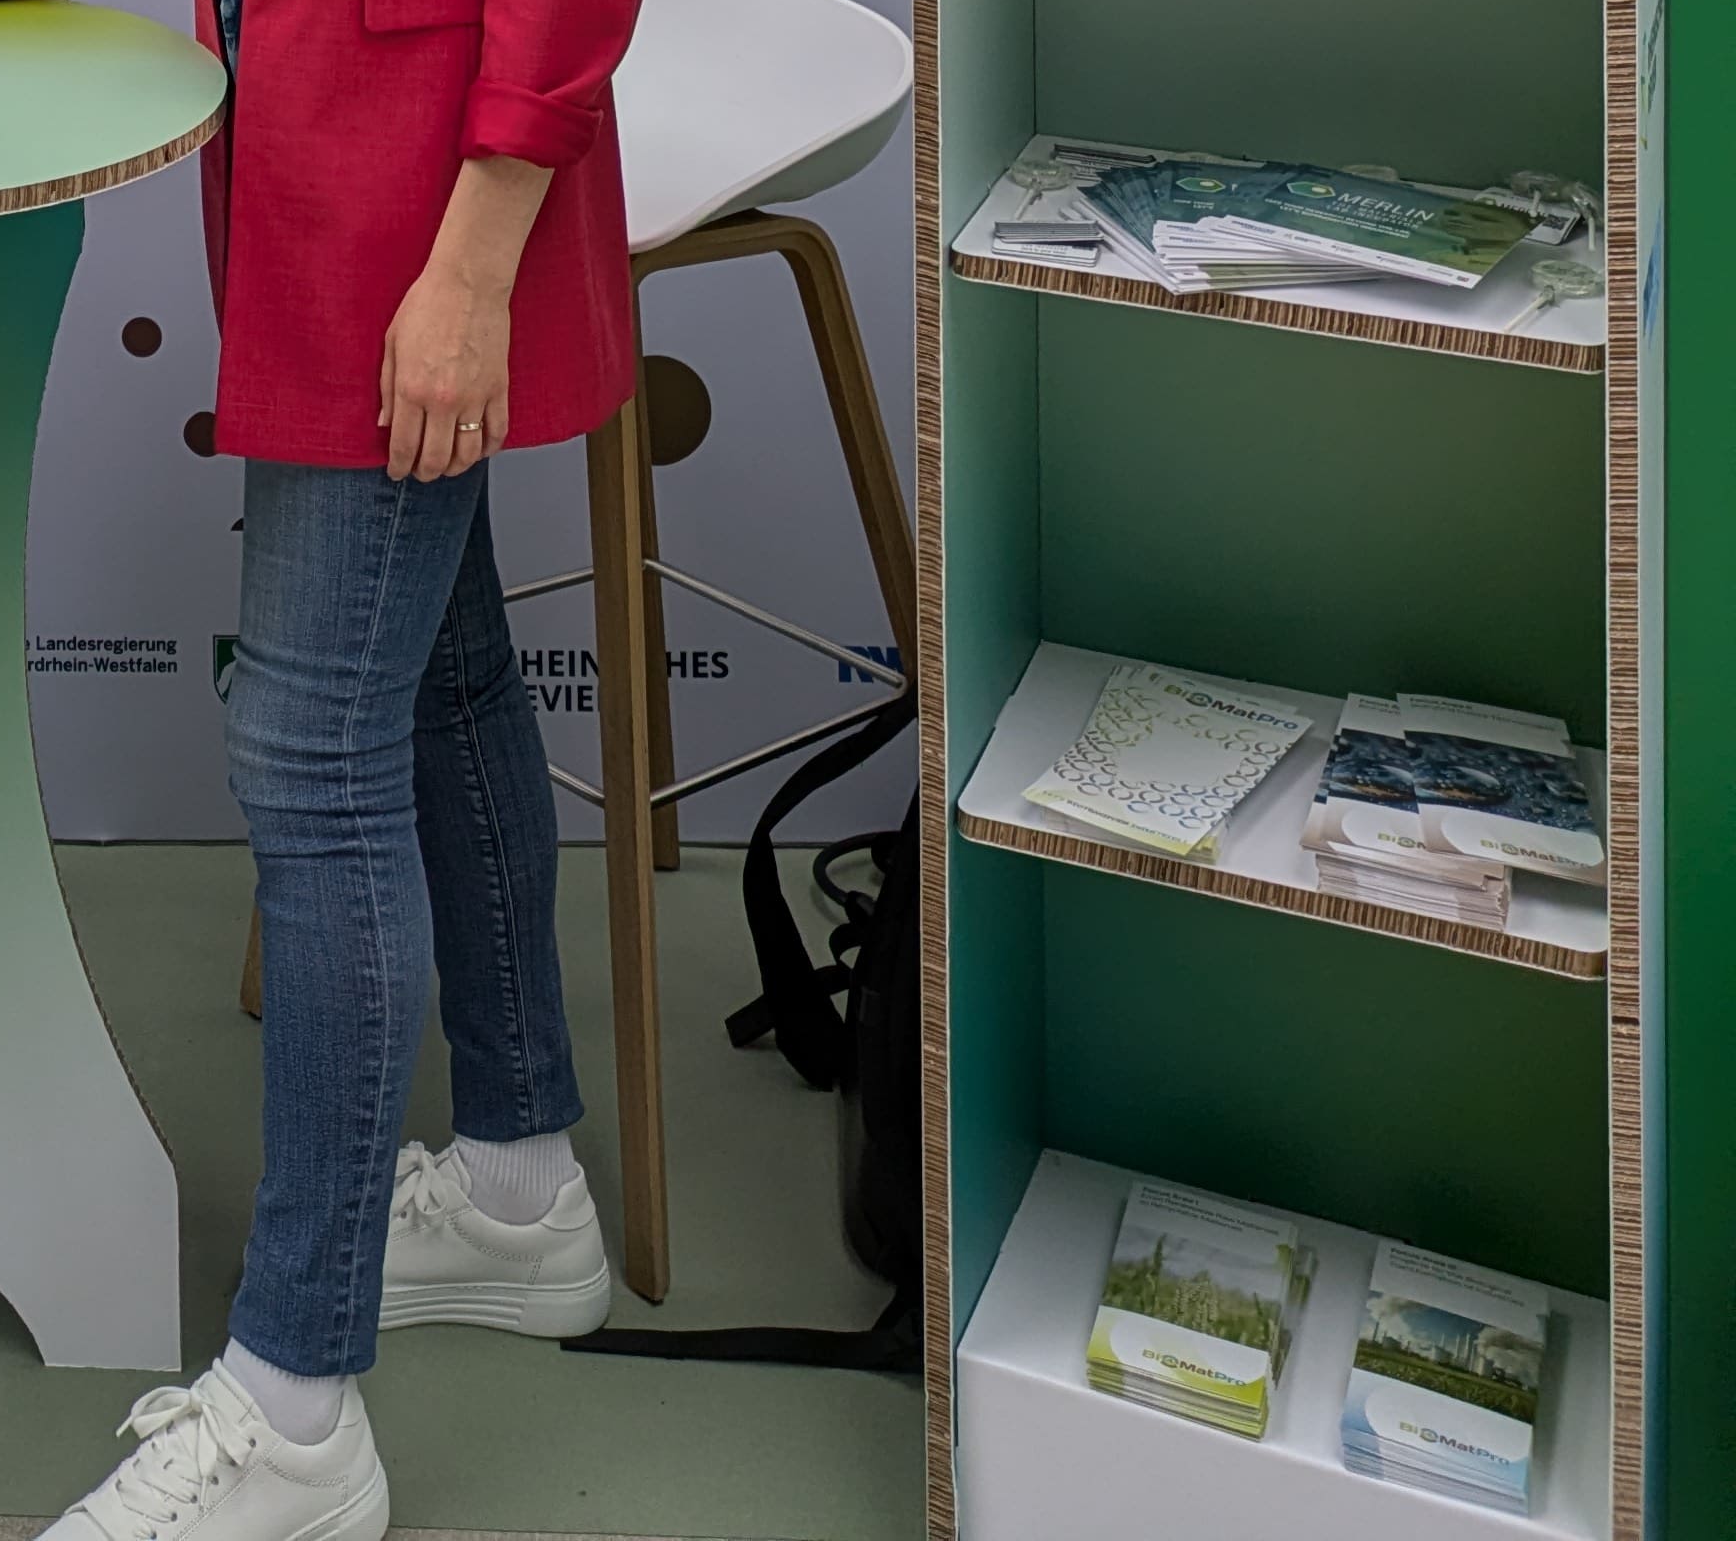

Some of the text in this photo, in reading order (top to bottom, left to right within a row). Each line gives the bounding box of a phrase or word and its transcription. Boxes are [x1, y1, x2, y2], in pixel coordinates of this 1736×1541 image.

[1337, 192, 1436, 222] MERLIN
[36, 635, 177, 654] Landesregierung
[27, 657, 178, 673] rdrhein-Westfalen
